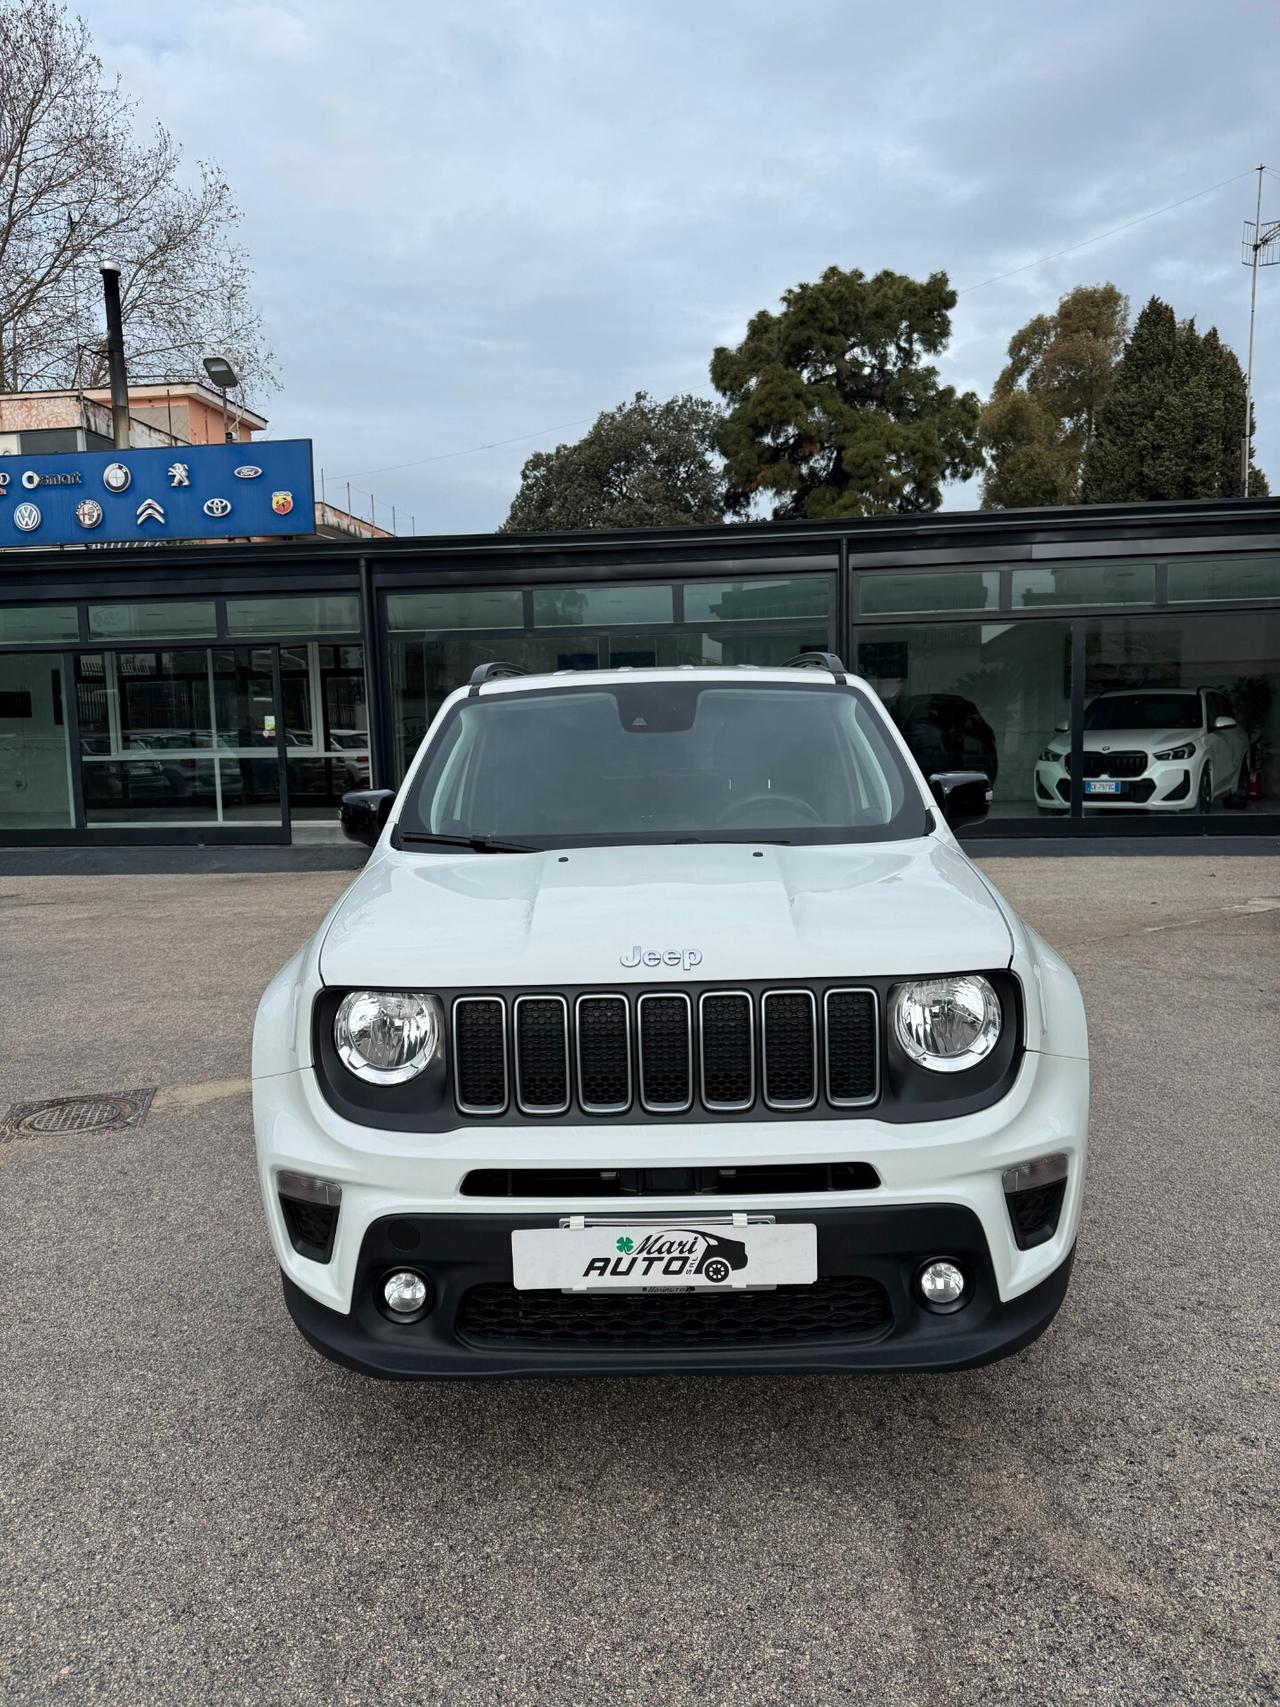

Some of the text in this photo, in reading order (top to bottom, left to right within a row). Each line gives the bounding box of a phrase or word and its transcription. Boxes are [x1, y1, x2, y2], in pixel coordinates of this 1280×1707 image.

[619, 945, 703, 971] Jeep
[623, 1234, 699, 1256] Mari
[582, 1255, 691, 1277] AUTO
